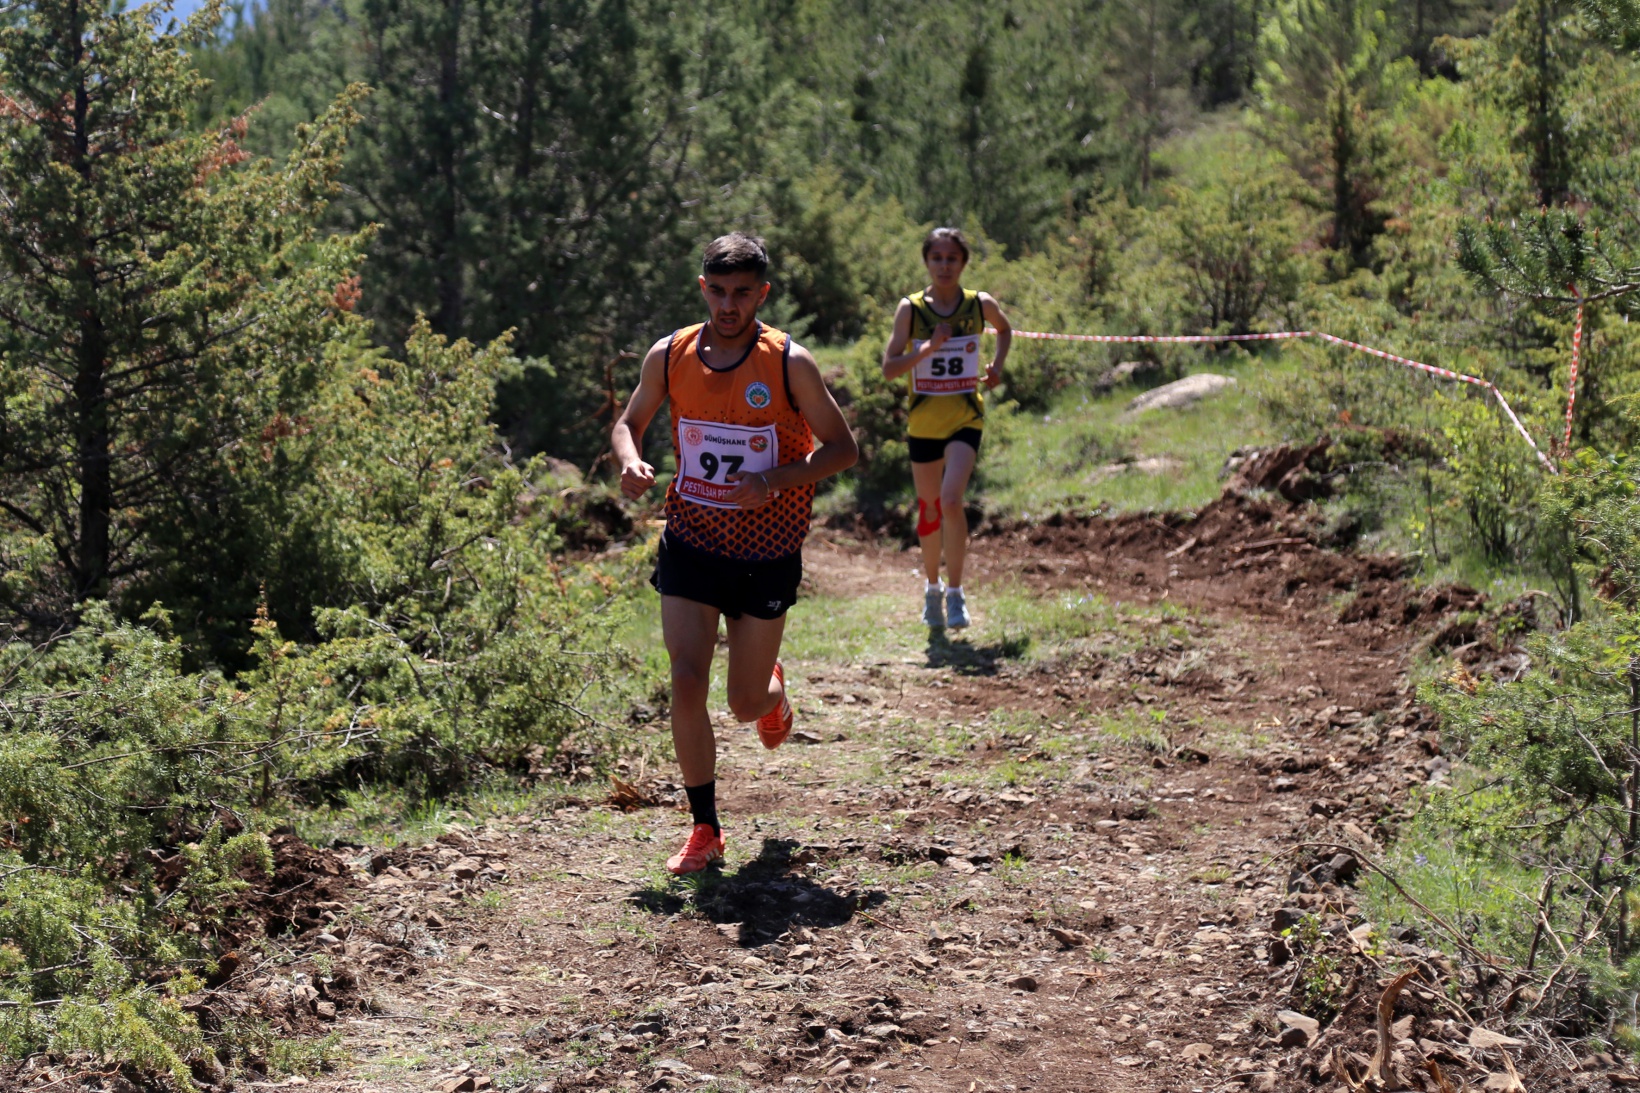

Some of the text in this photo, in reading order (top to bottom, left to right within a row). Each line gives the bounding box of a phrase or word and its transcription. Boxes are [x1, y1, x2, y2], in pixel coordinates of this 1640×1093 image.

[931, 357, 964, 376] 58
[704, 434, 746, 446] GÜMÜŞHANE
[700, 452, 744, 483] 97
[683, 481, 717, 498] PESTİLŞAH
